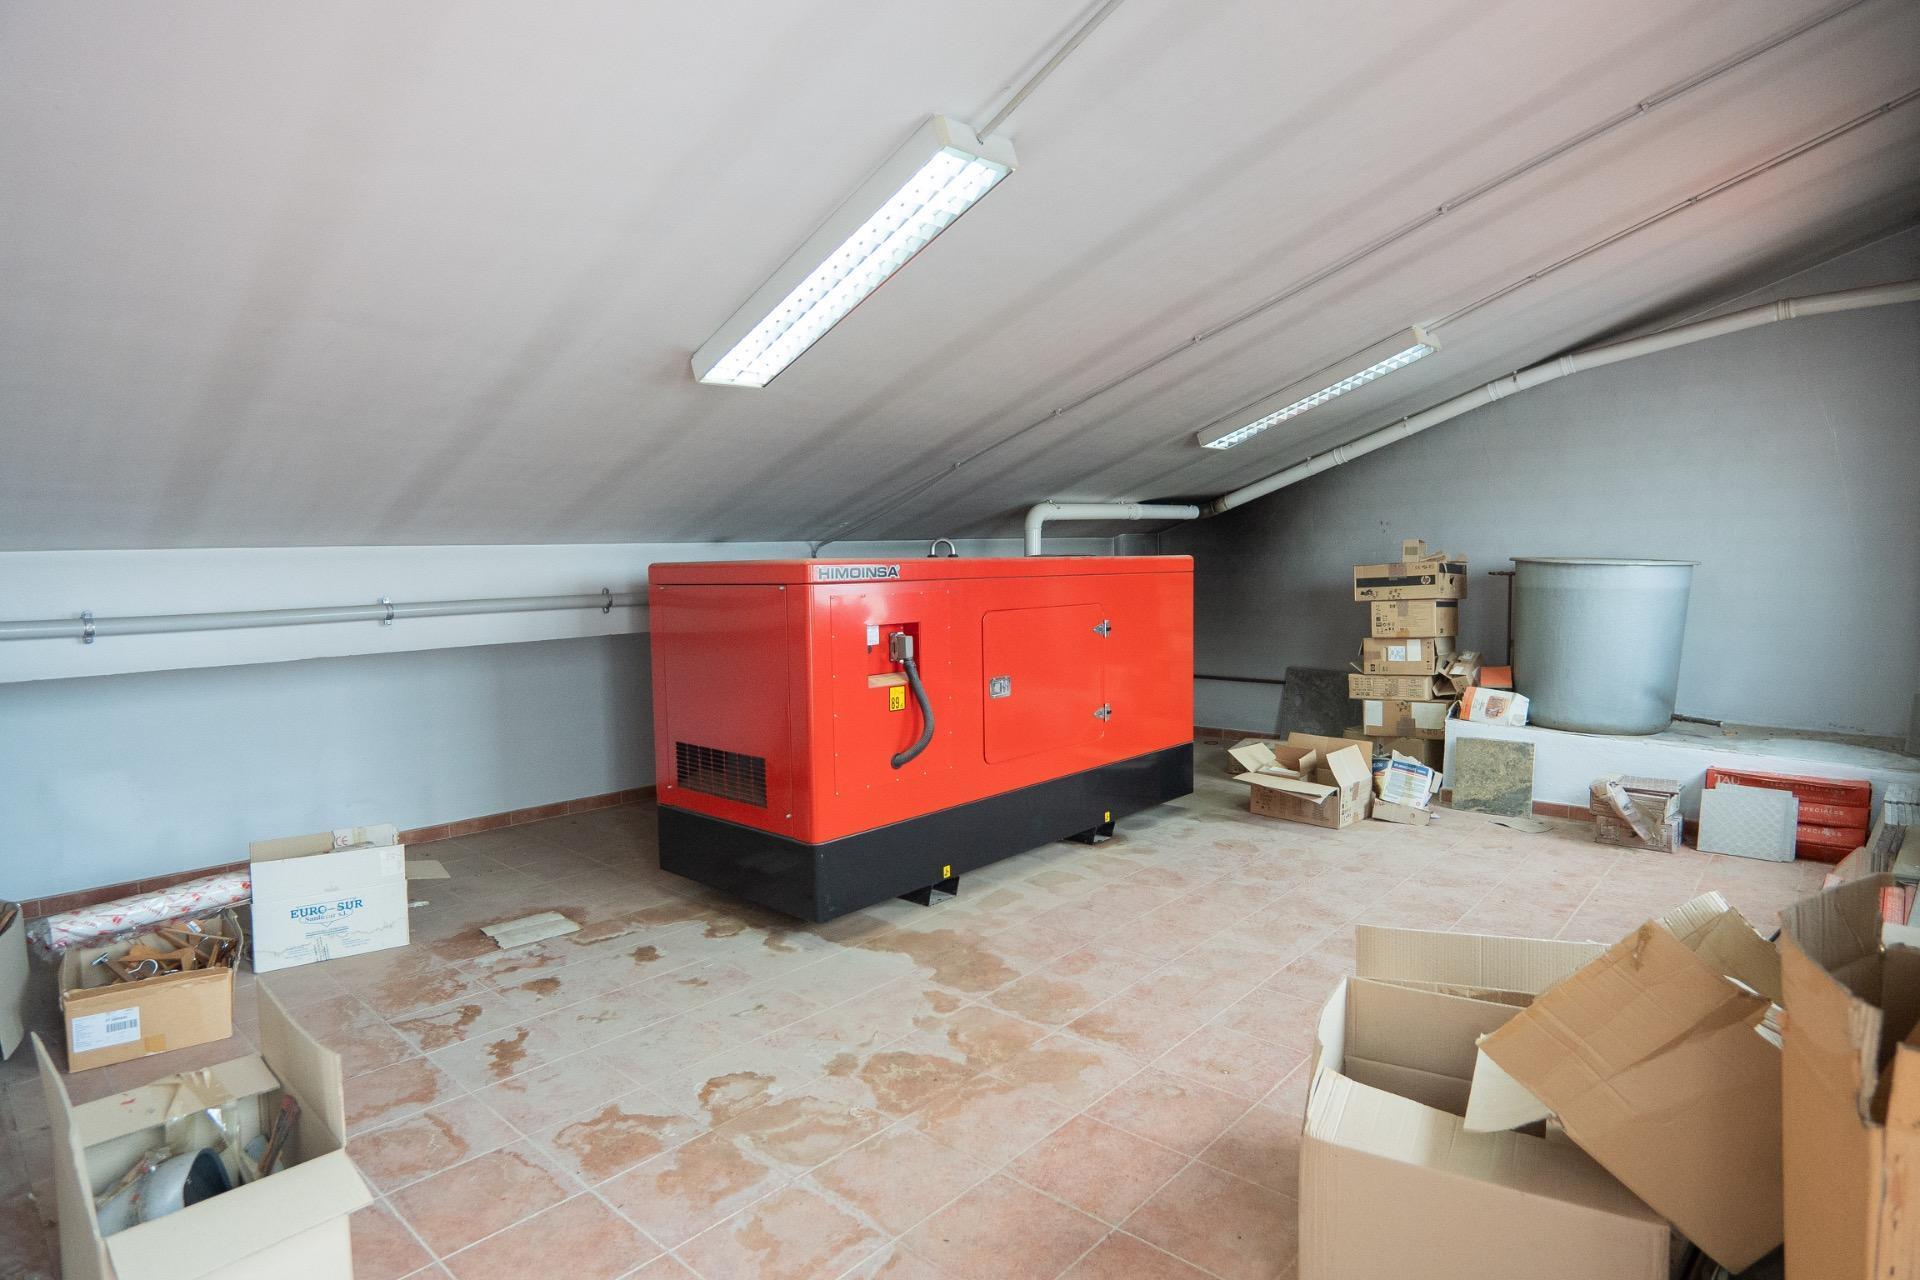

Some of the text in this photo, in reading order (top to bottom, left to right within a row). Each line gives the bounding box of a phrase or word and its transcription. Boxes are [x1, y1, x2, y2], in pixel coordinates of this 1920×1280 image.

[818, 566, 898, 580] HIMOINSA
[1714, 774, 1740, 785] TAU
[1800, 806, 1844, 816] SPECIALES
